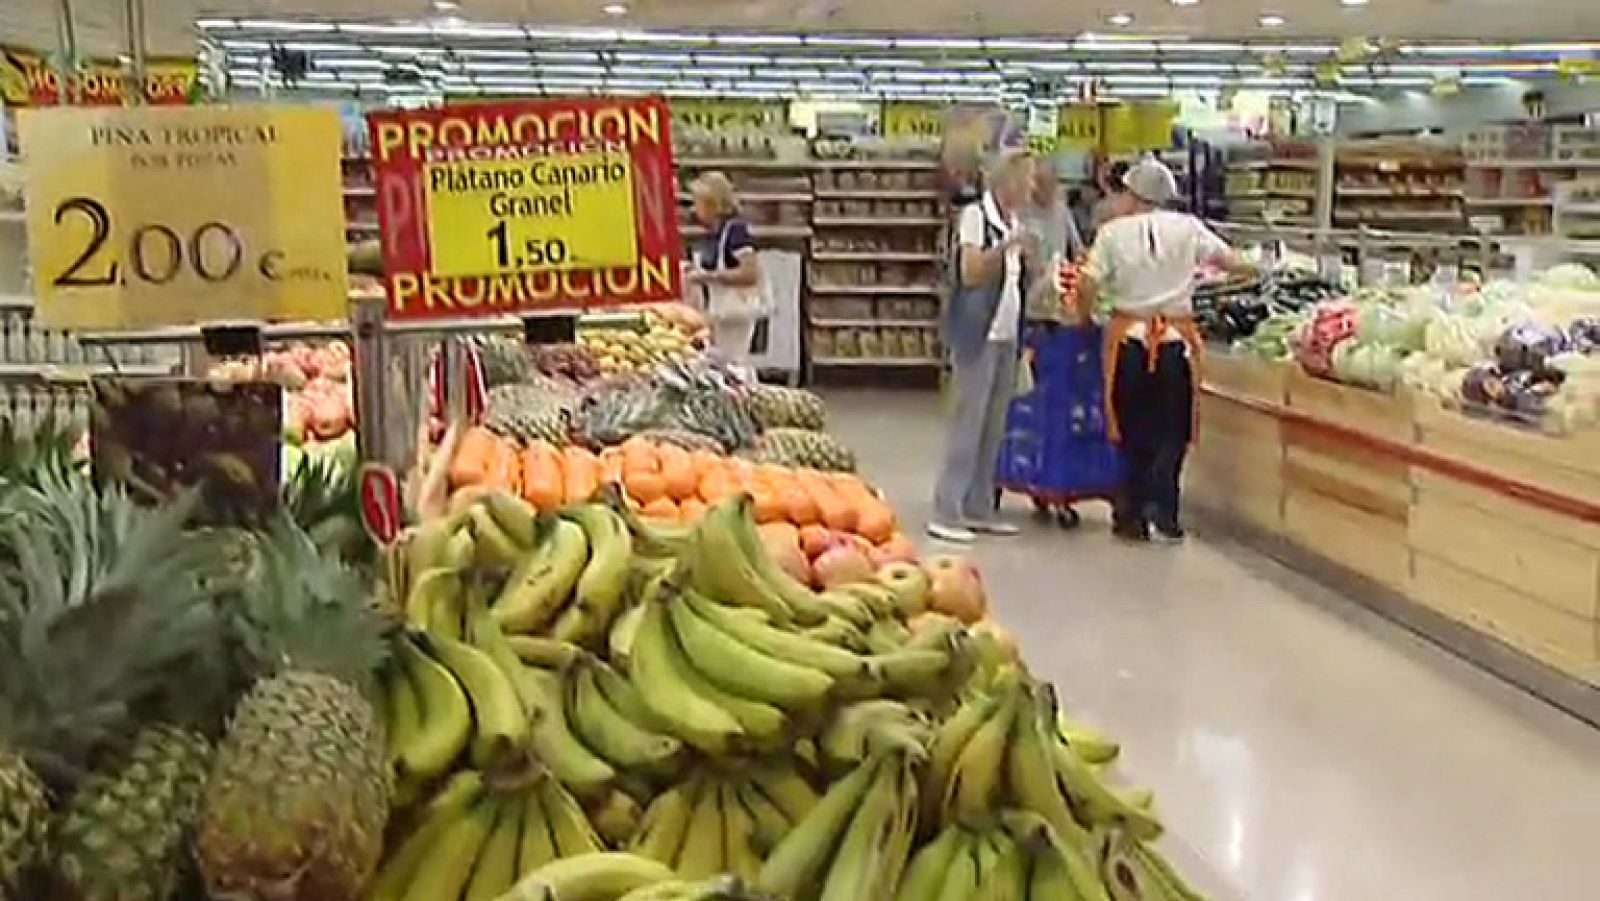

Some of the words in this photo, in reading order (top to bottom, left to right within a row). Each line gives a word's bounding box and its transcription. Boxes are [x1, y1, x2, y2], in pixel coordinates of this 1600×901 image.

[377, 106, 661, 161] PROMOCION
[529, 157, 626, 188] Canario
[489, 189, 573, 219] Granel
[392, 255, 671, 312] PROMOCION
